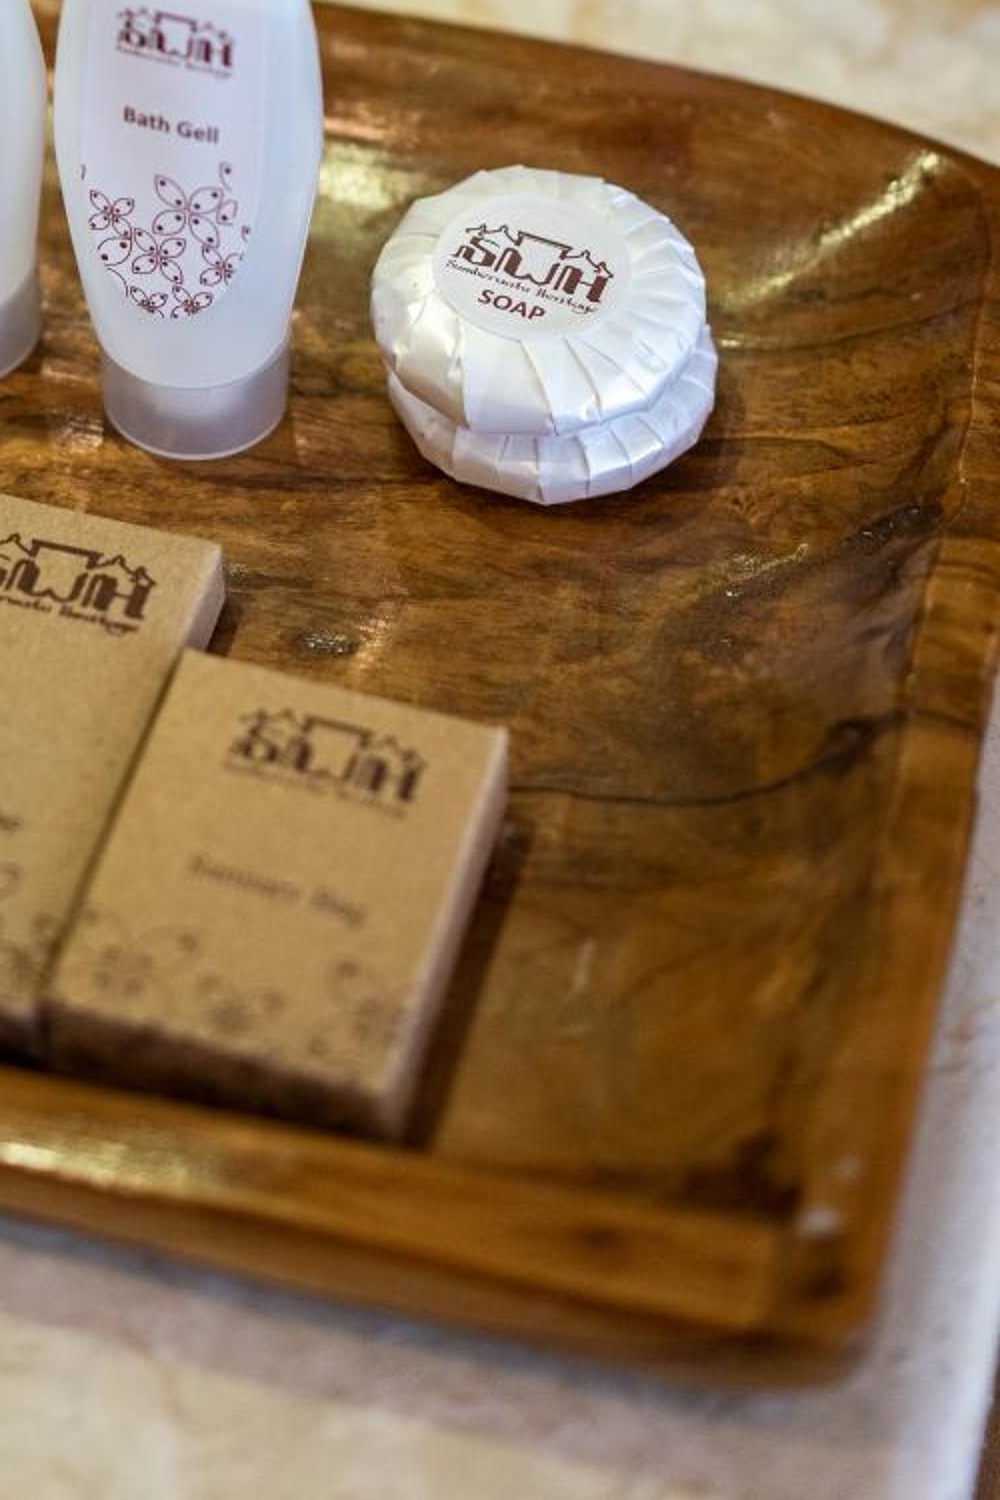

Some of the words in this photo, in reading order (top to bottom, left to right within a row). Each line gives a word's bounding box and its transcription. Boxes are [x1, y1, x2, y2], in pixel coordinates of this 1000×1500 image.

[123, 106, 170, 133] Bath
[177, 121, 219, 144] Gell
[477, 289, 546, 319] SOAP
